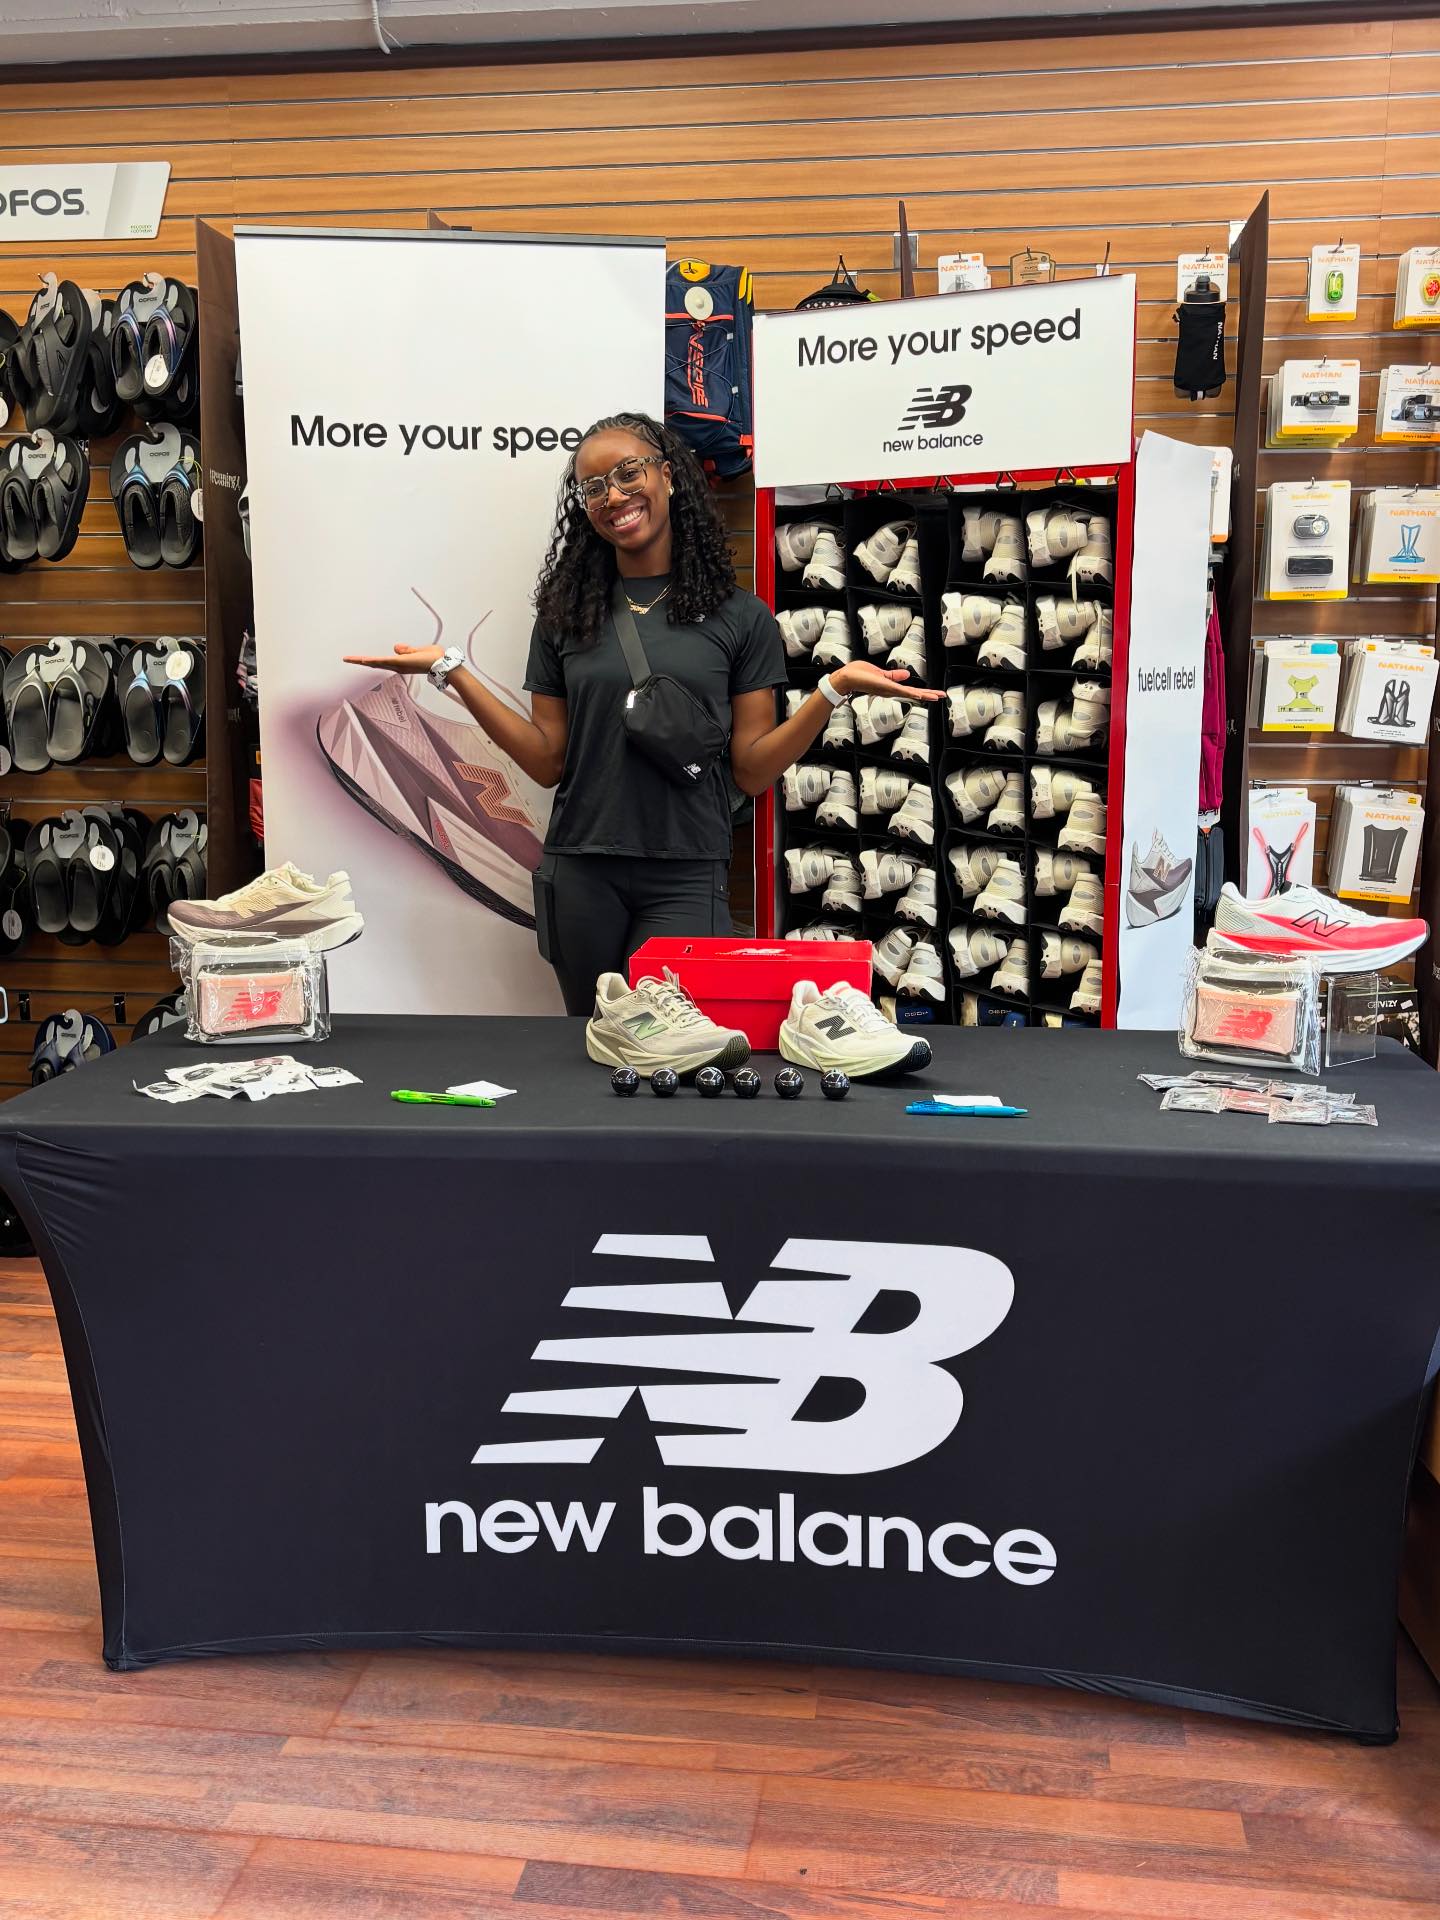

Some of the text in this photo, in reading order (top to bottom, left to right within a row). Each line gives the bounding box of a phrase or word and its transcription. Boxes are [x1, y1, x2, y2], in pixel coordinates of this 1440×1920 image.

[0, 188, 85, 216] FOS
[799, 308, 1081, 366] More your speed
[291, 415, 584, 458] More your spee
[883, 433, 984, 453] new balance
[1138, 666, 1172, 692] fuelcell
[1173, 665, 1196, 690] rebel
[425, 1486, 1058, 1586] new balance
